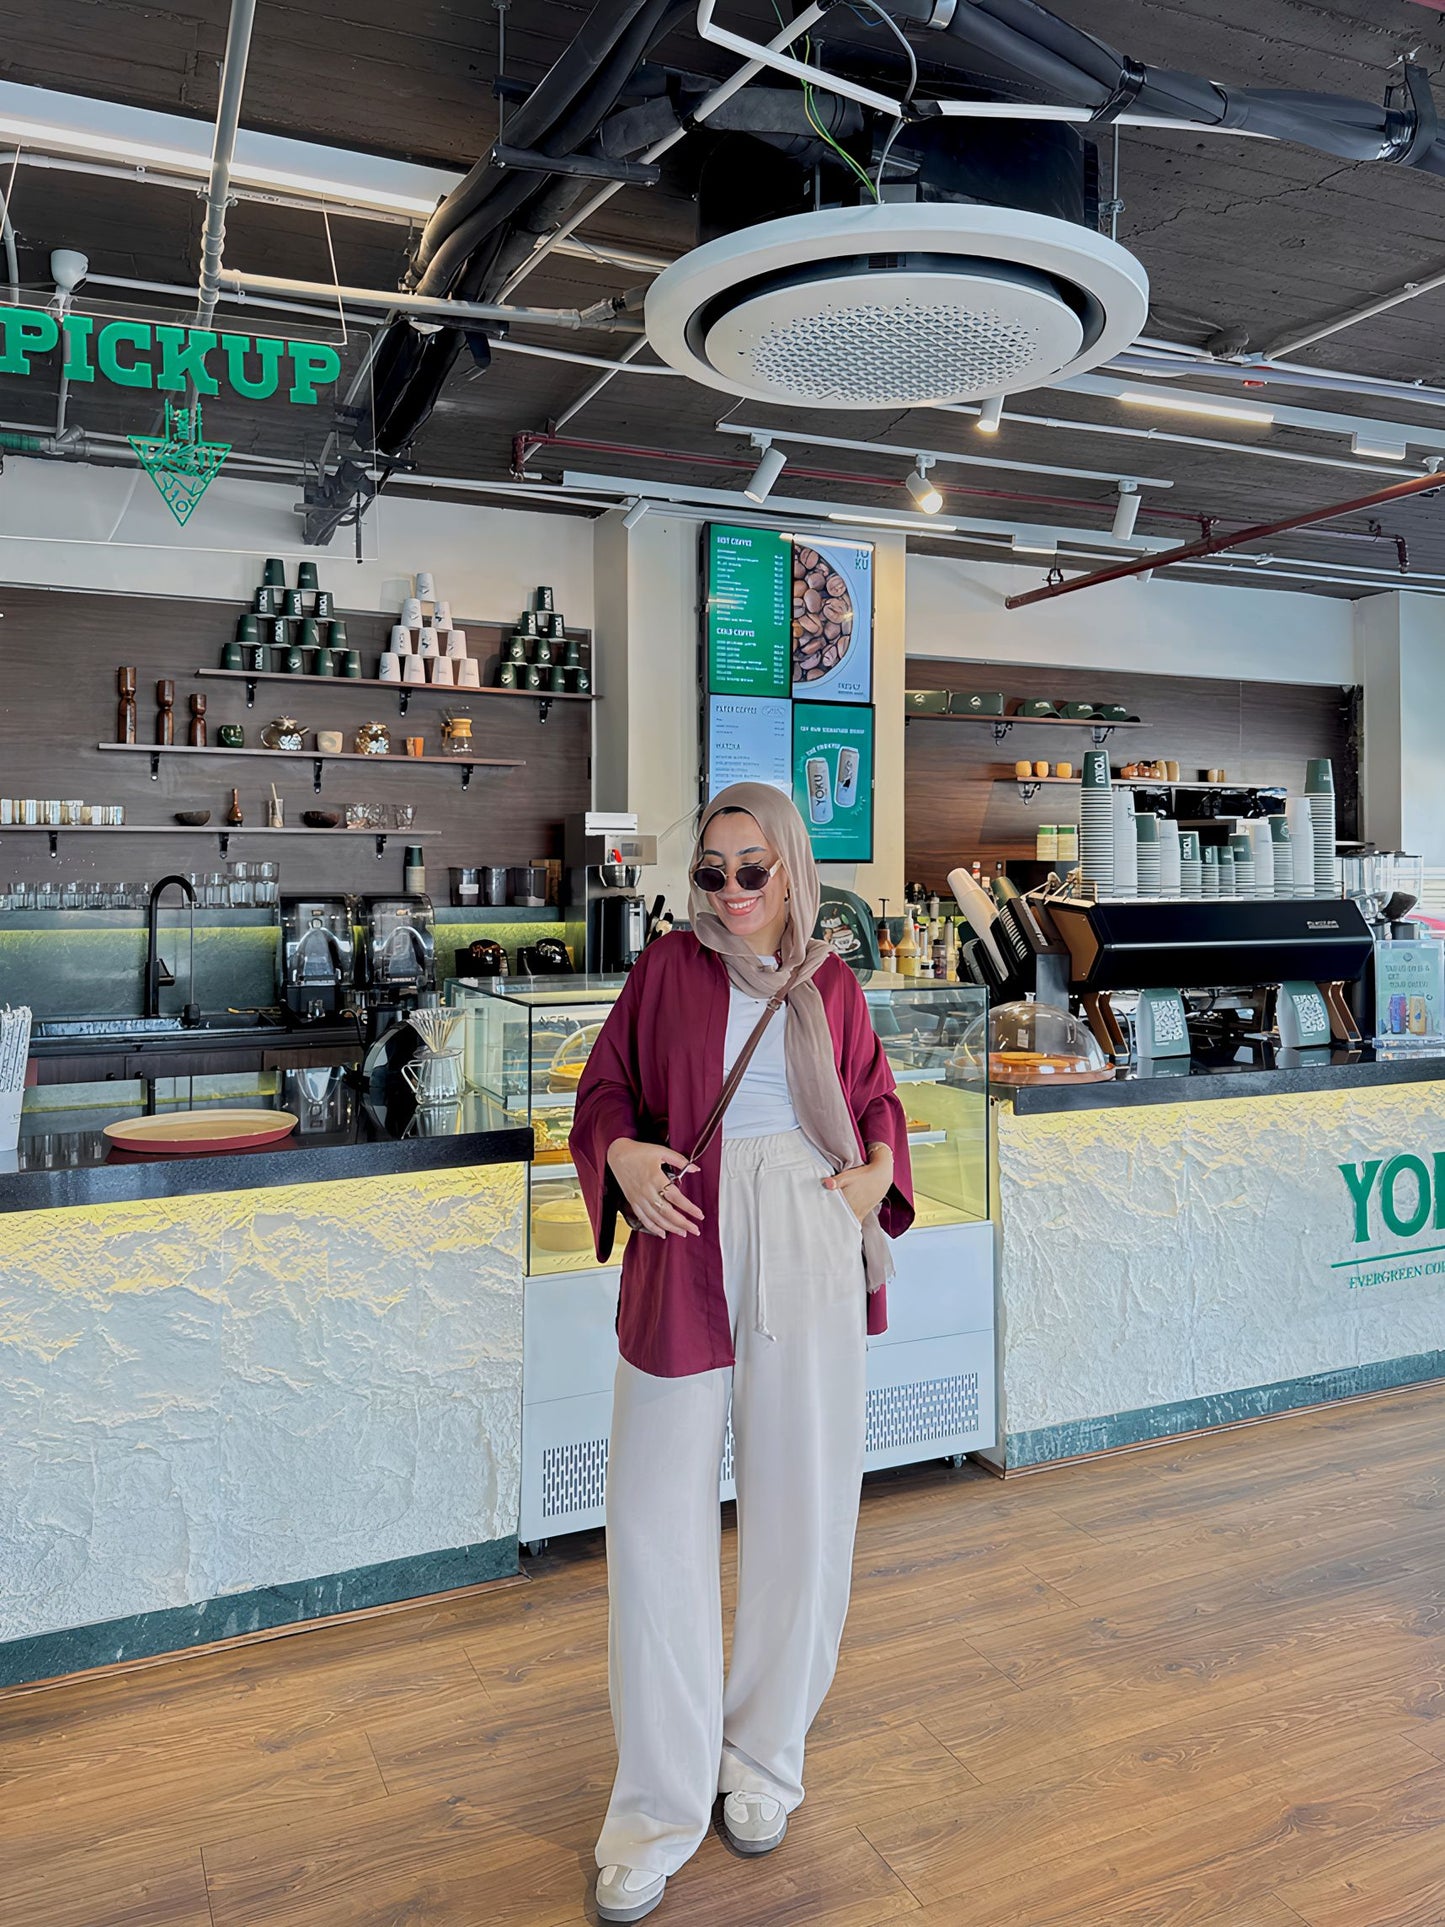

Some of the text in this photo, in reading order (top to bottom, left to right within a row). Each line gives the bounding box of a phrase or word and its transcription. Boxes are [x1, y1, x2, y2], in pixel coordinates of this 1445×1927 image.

[0, 307, 341, 405] PICKUP
[815, 774, 826, 807] YOKU
[1338, 1152, 1445, 1243] YO
[1349, 1264, 1422, 1289] EVERGREEN
